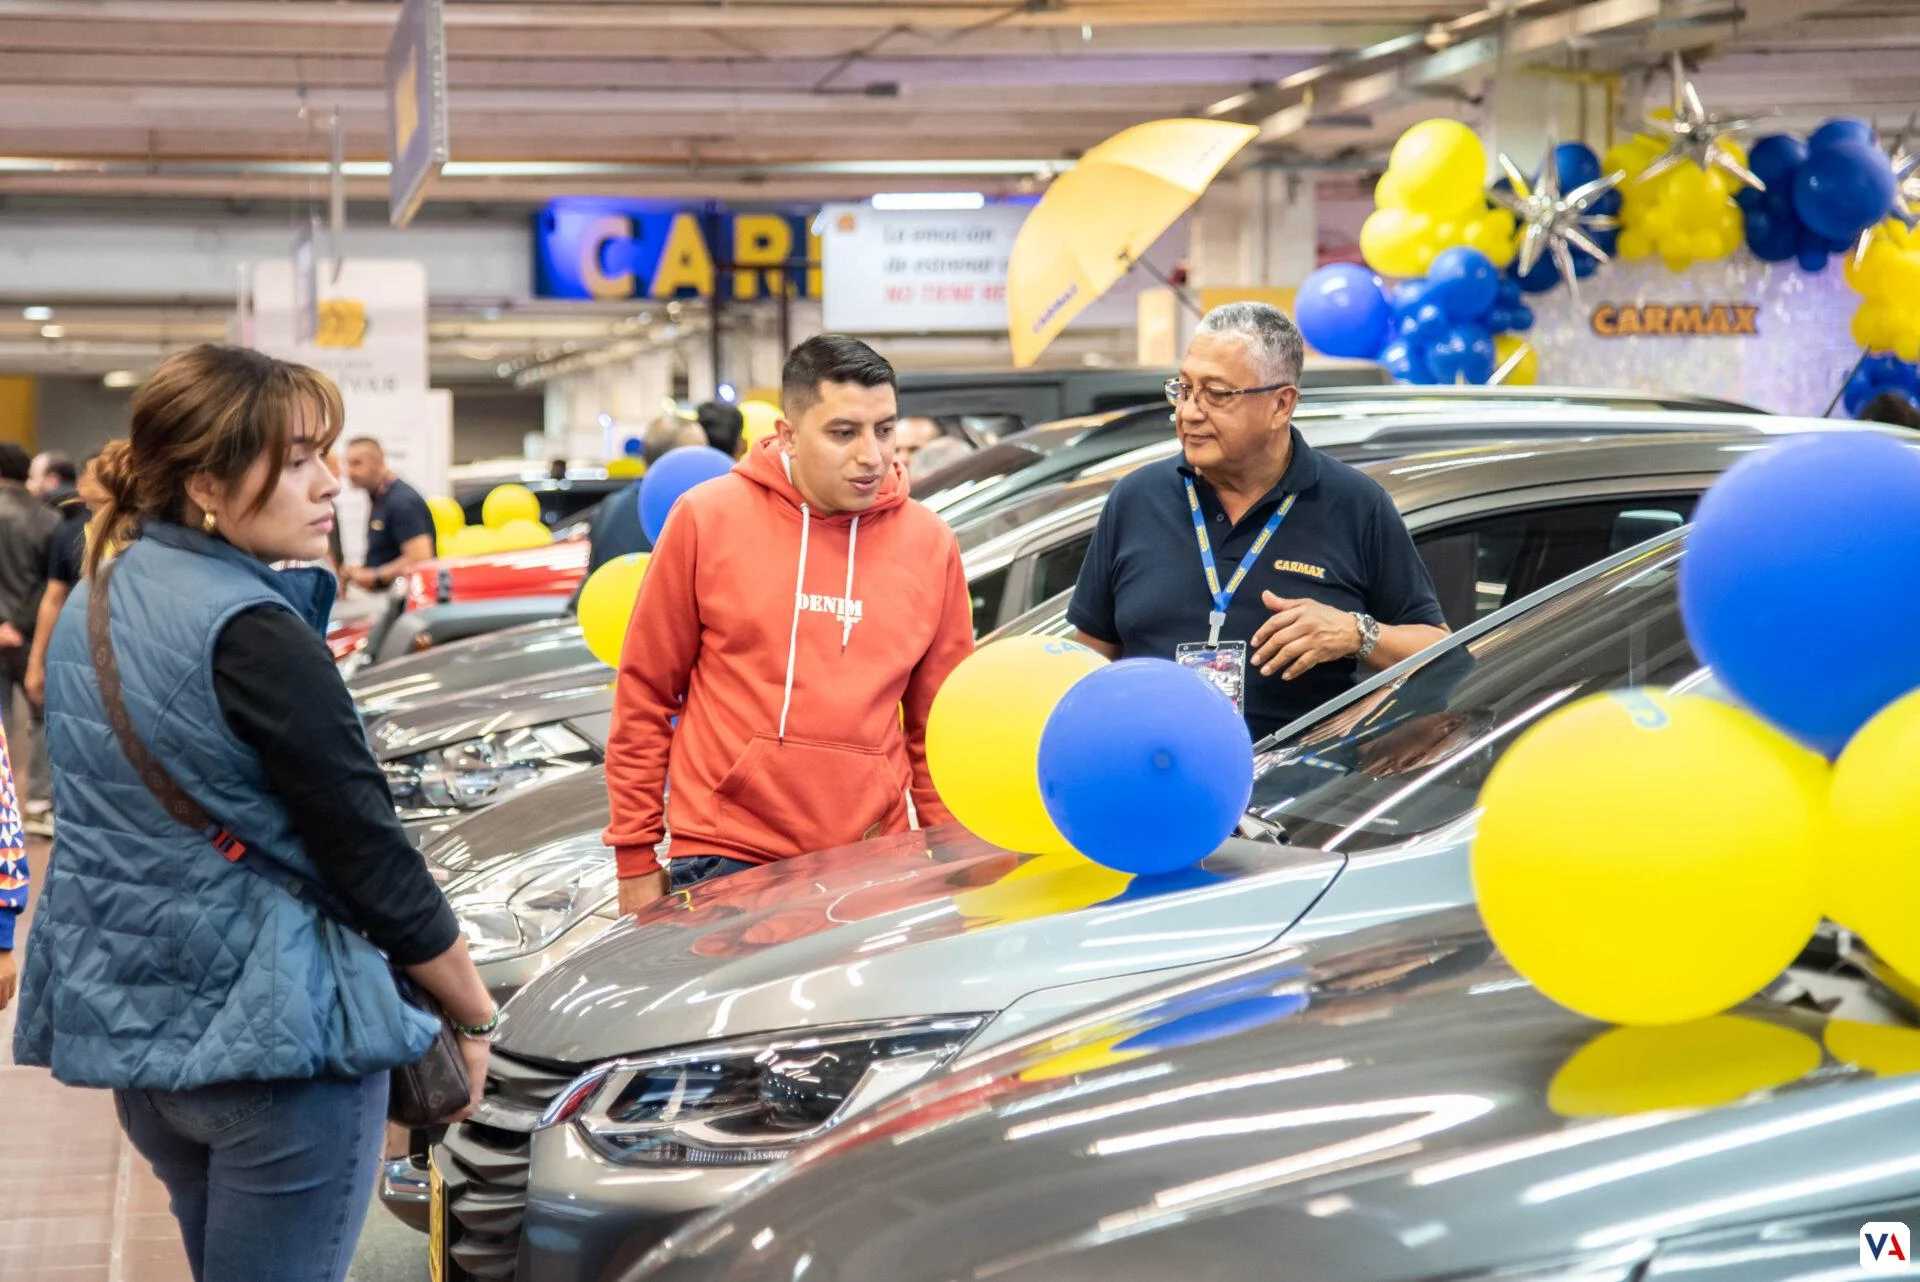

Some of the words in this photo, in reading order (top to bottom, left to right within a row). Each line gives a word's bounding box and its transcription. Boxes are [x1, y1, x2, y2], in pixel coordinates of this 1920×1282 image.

[580, 214, 822, 298] CAR
[885, 284, 914, 303] NO
[921, 284, 975, 303] TIENE
[1591, 303, 1759, 336] CARMAX
[1274, 559, 1326, 579] CARMAX
[795, 592, 863, 617] DENIM
